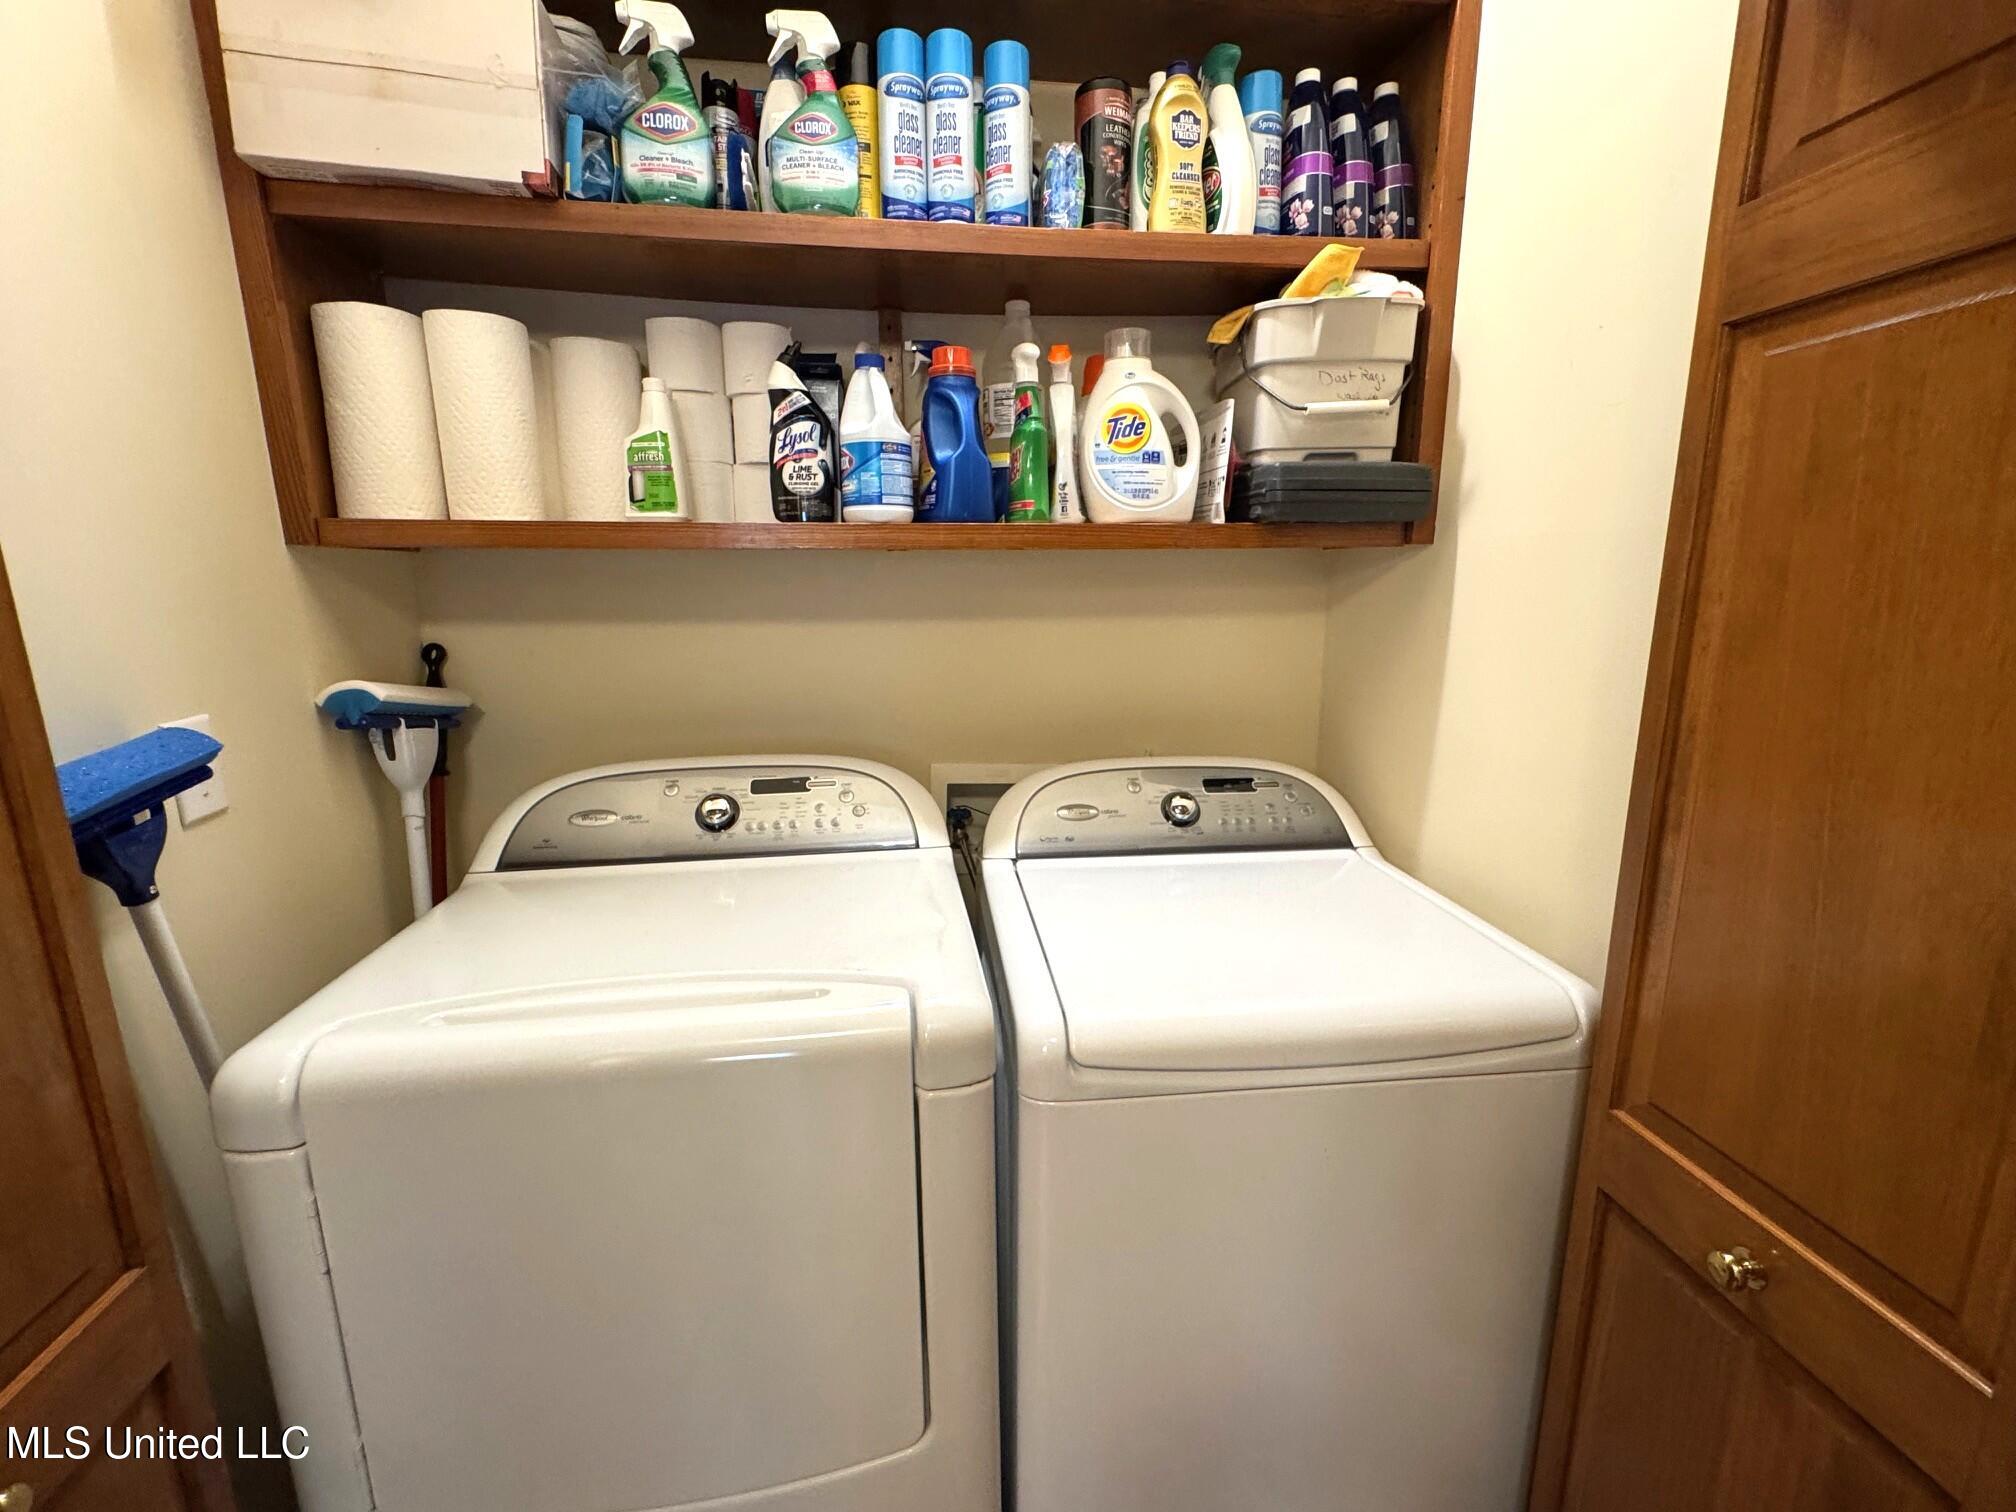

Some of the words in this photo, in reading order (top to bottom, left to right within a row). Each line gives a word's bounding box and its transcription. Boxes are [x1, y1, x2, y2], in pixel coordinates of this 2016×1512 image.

[930, 81, 965, 96] Sprayway
[641, 112, 689, 131] CLOROX
[898, 109, 919, 133] glass
[936, 110, 957, 134] glass
[1179, 114, 1195, 124] BAR
[794, 121, 832, 135] CLOROX
[988, 122, 1007, 147] glass
[1172, 122, 1201, 133] KEEPERS
[1173, 130, 1199, 141] FRIEND
[894, 133, 923, 158] cleaner
[932, 135, 962, 156] cleaner
[786, 156, 838, 164] MULTI-SURFACE
[985, 145, 1012, 168] cleaner
[782, 163, 811, 171] CLEANER
[818, 163, 844, 172] BLEACH
[1179, 162, 1194, 171] SOFT
[1171, 172, 1200, 182] CLEANSER
[1359, 367, 1386, 392] Rags
[1107, 415, 1147, 445] Tide
[777, 423, 817, 454] Lysol
[633, 450, 665, 462] affresh
[1095, 455, 1109, 463] free
[1117, 455, 1140, 464] gentle
[792, 465, 813, 474] LIME
